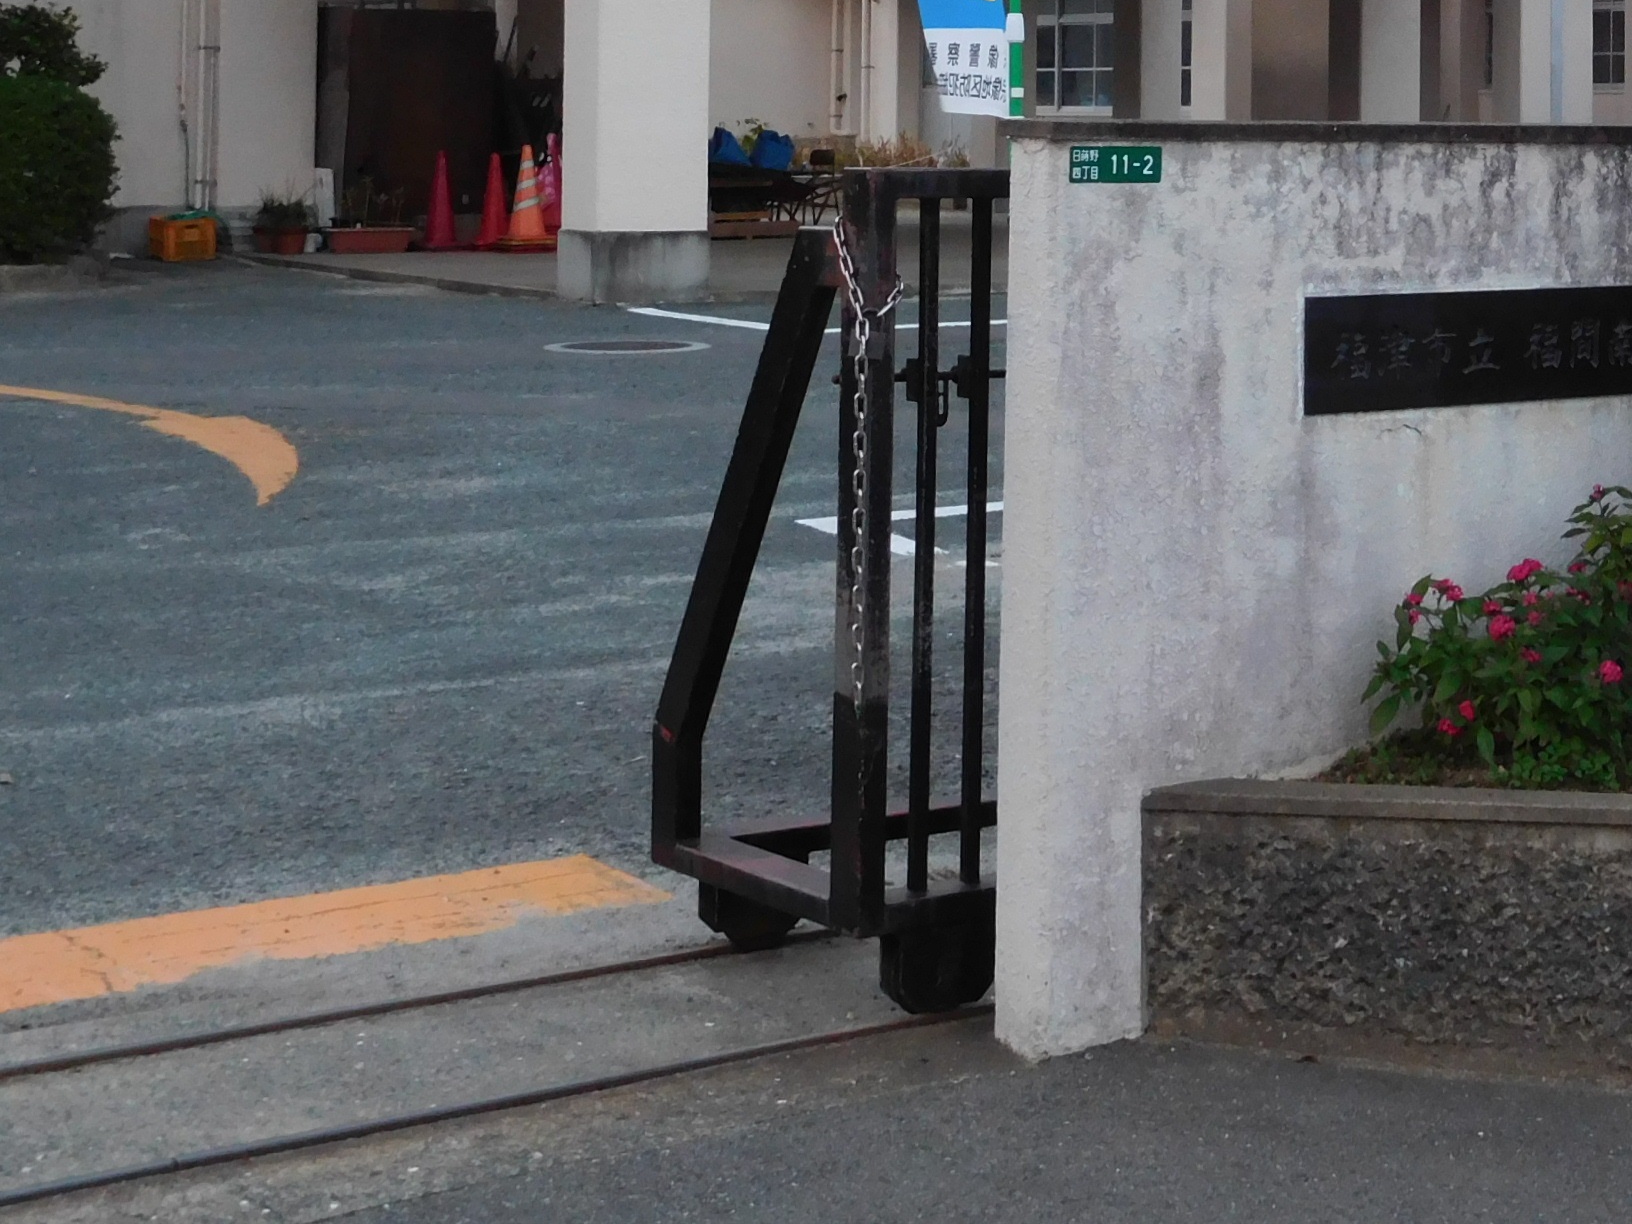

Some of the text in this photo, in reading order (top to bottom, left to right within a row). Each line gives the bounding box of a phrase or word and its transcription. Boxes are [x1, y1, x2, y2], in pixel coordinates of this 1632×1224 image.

[1072, 149, 1099, 162] 日蒔野
[1110, 154, 1154, 175] 11-2
[1072, 165, 1099, 180] 四丁目
